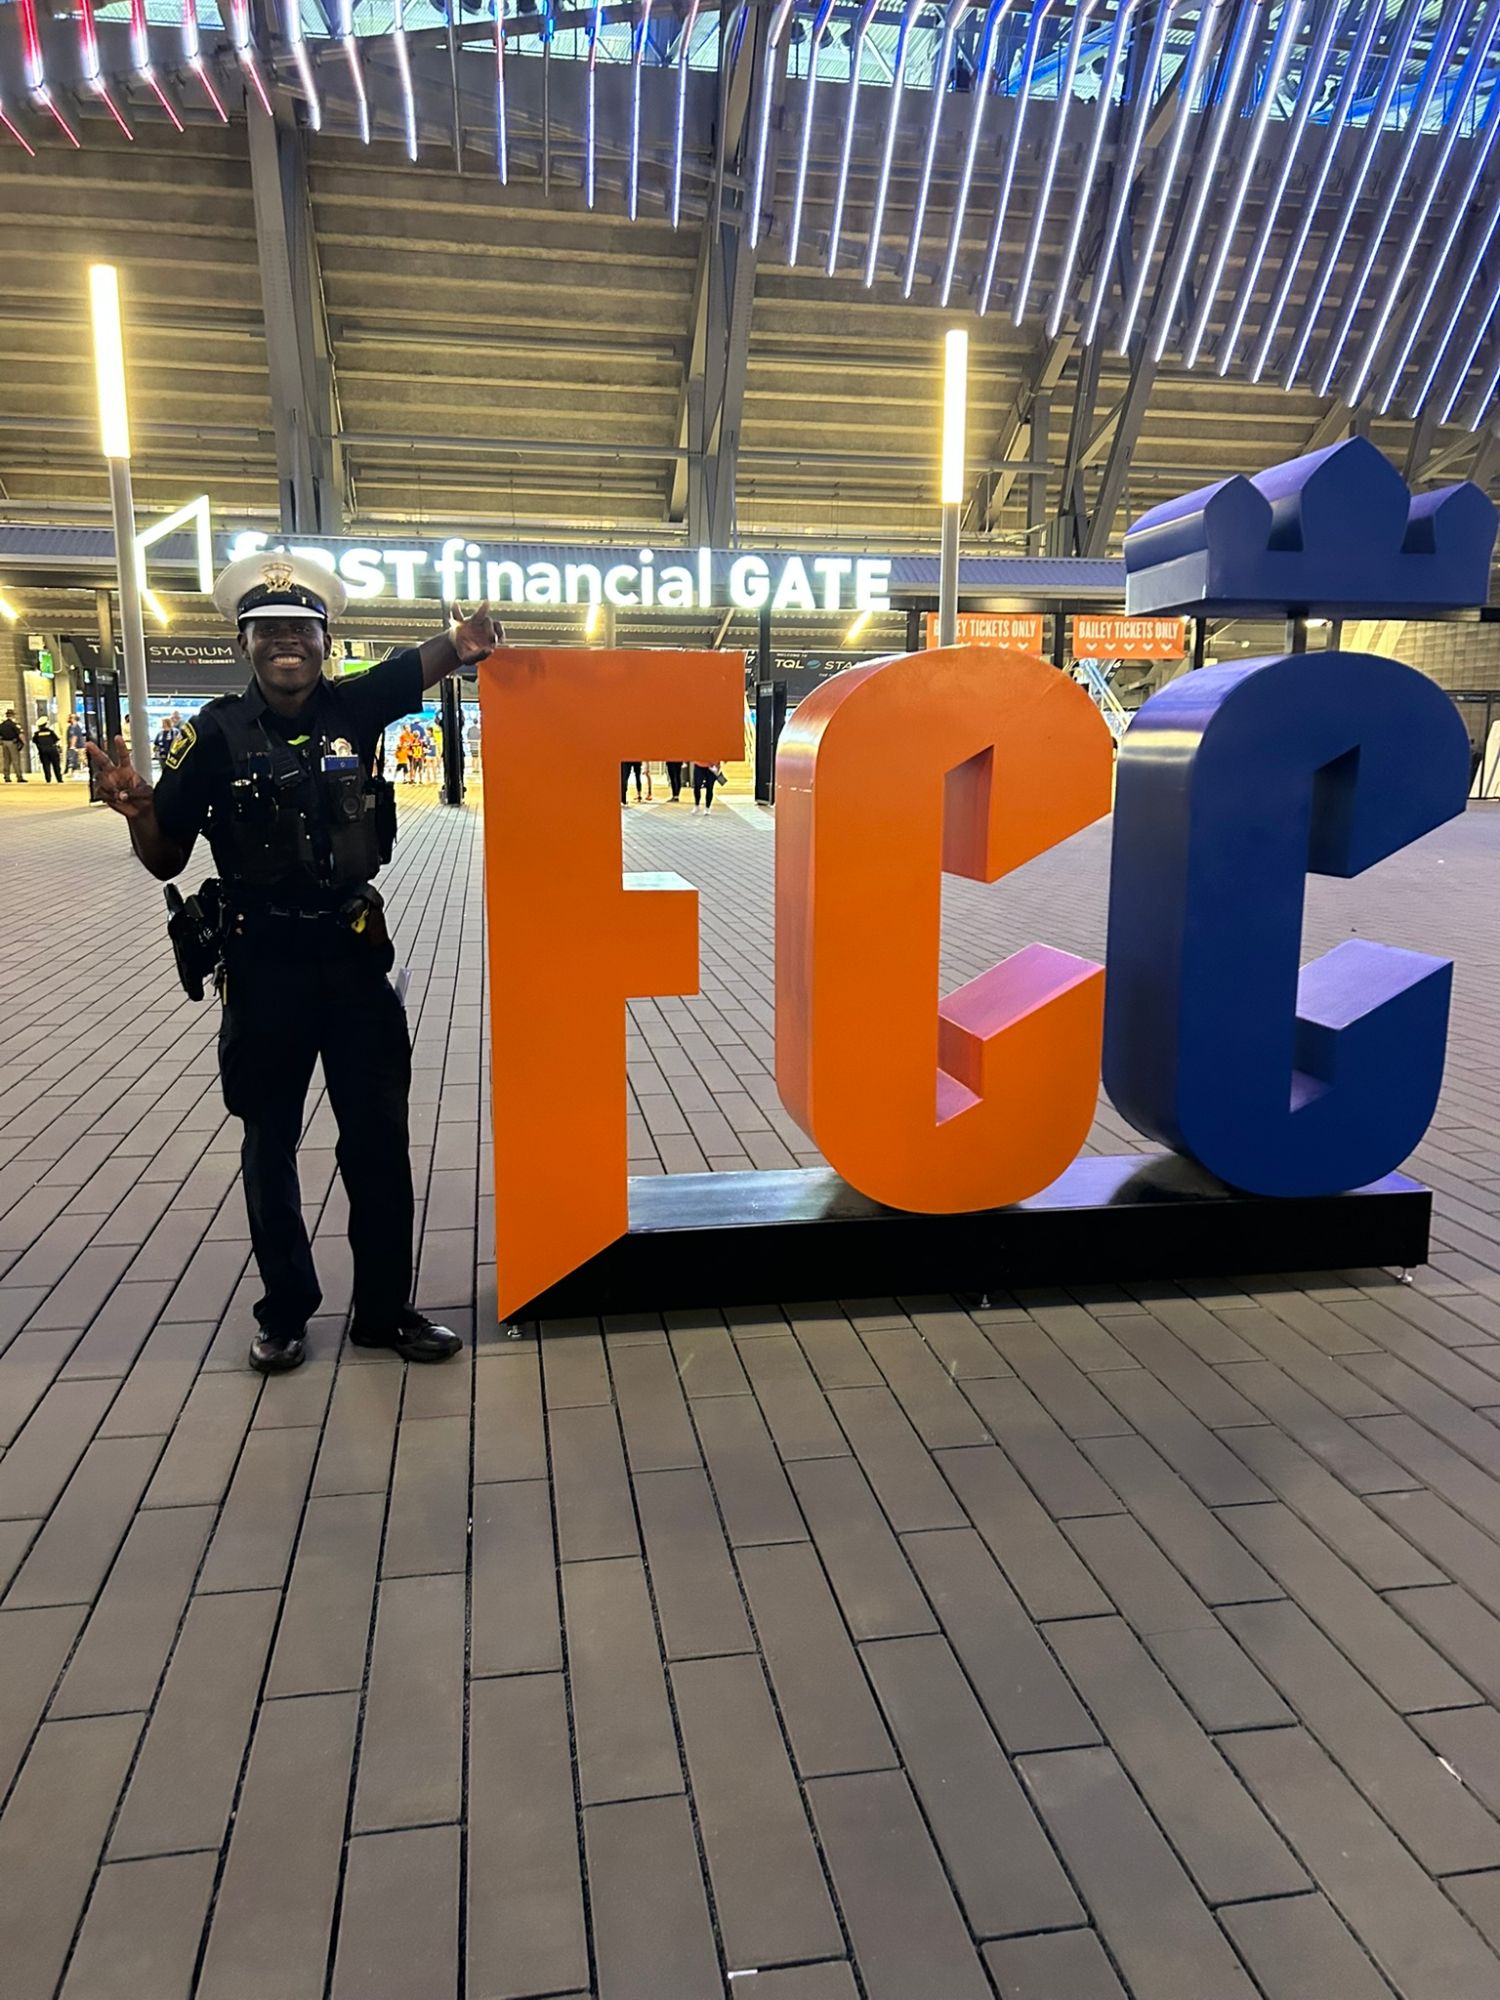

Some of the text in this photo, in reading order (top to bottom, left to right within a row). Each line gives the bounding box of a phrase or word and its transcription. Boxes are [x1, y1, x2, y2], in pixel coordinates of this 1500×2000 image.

[434, 537, 712, 608] financial
[729, 555, 892, 611] GATE
[933, 619, 1036, 638] BEY TICKETS ONLY
[1079, 621, 1179, 640] BAILEY TICKETS ONLY
[149, 646, 233, 656] STADIUM
[774, 658, 805, 669] TQL
[480, 645, 1471, 1322] FCC
